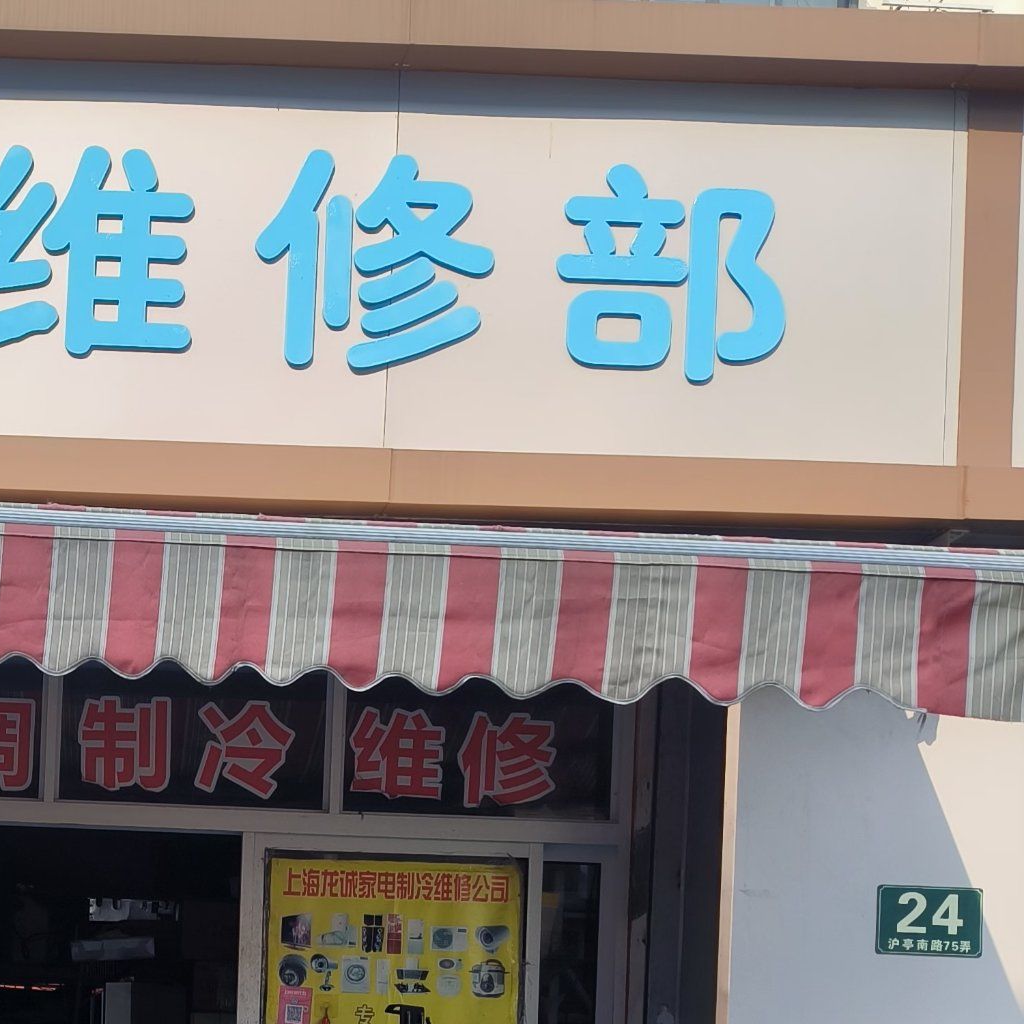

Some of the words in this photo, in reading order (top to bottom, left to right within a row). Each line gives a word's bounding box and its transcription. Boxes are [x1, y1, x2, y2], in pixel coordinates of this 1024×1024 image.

[896, 892, 964, 935] 24
[888, 938, 972, 953] 沪亭南路75弄
